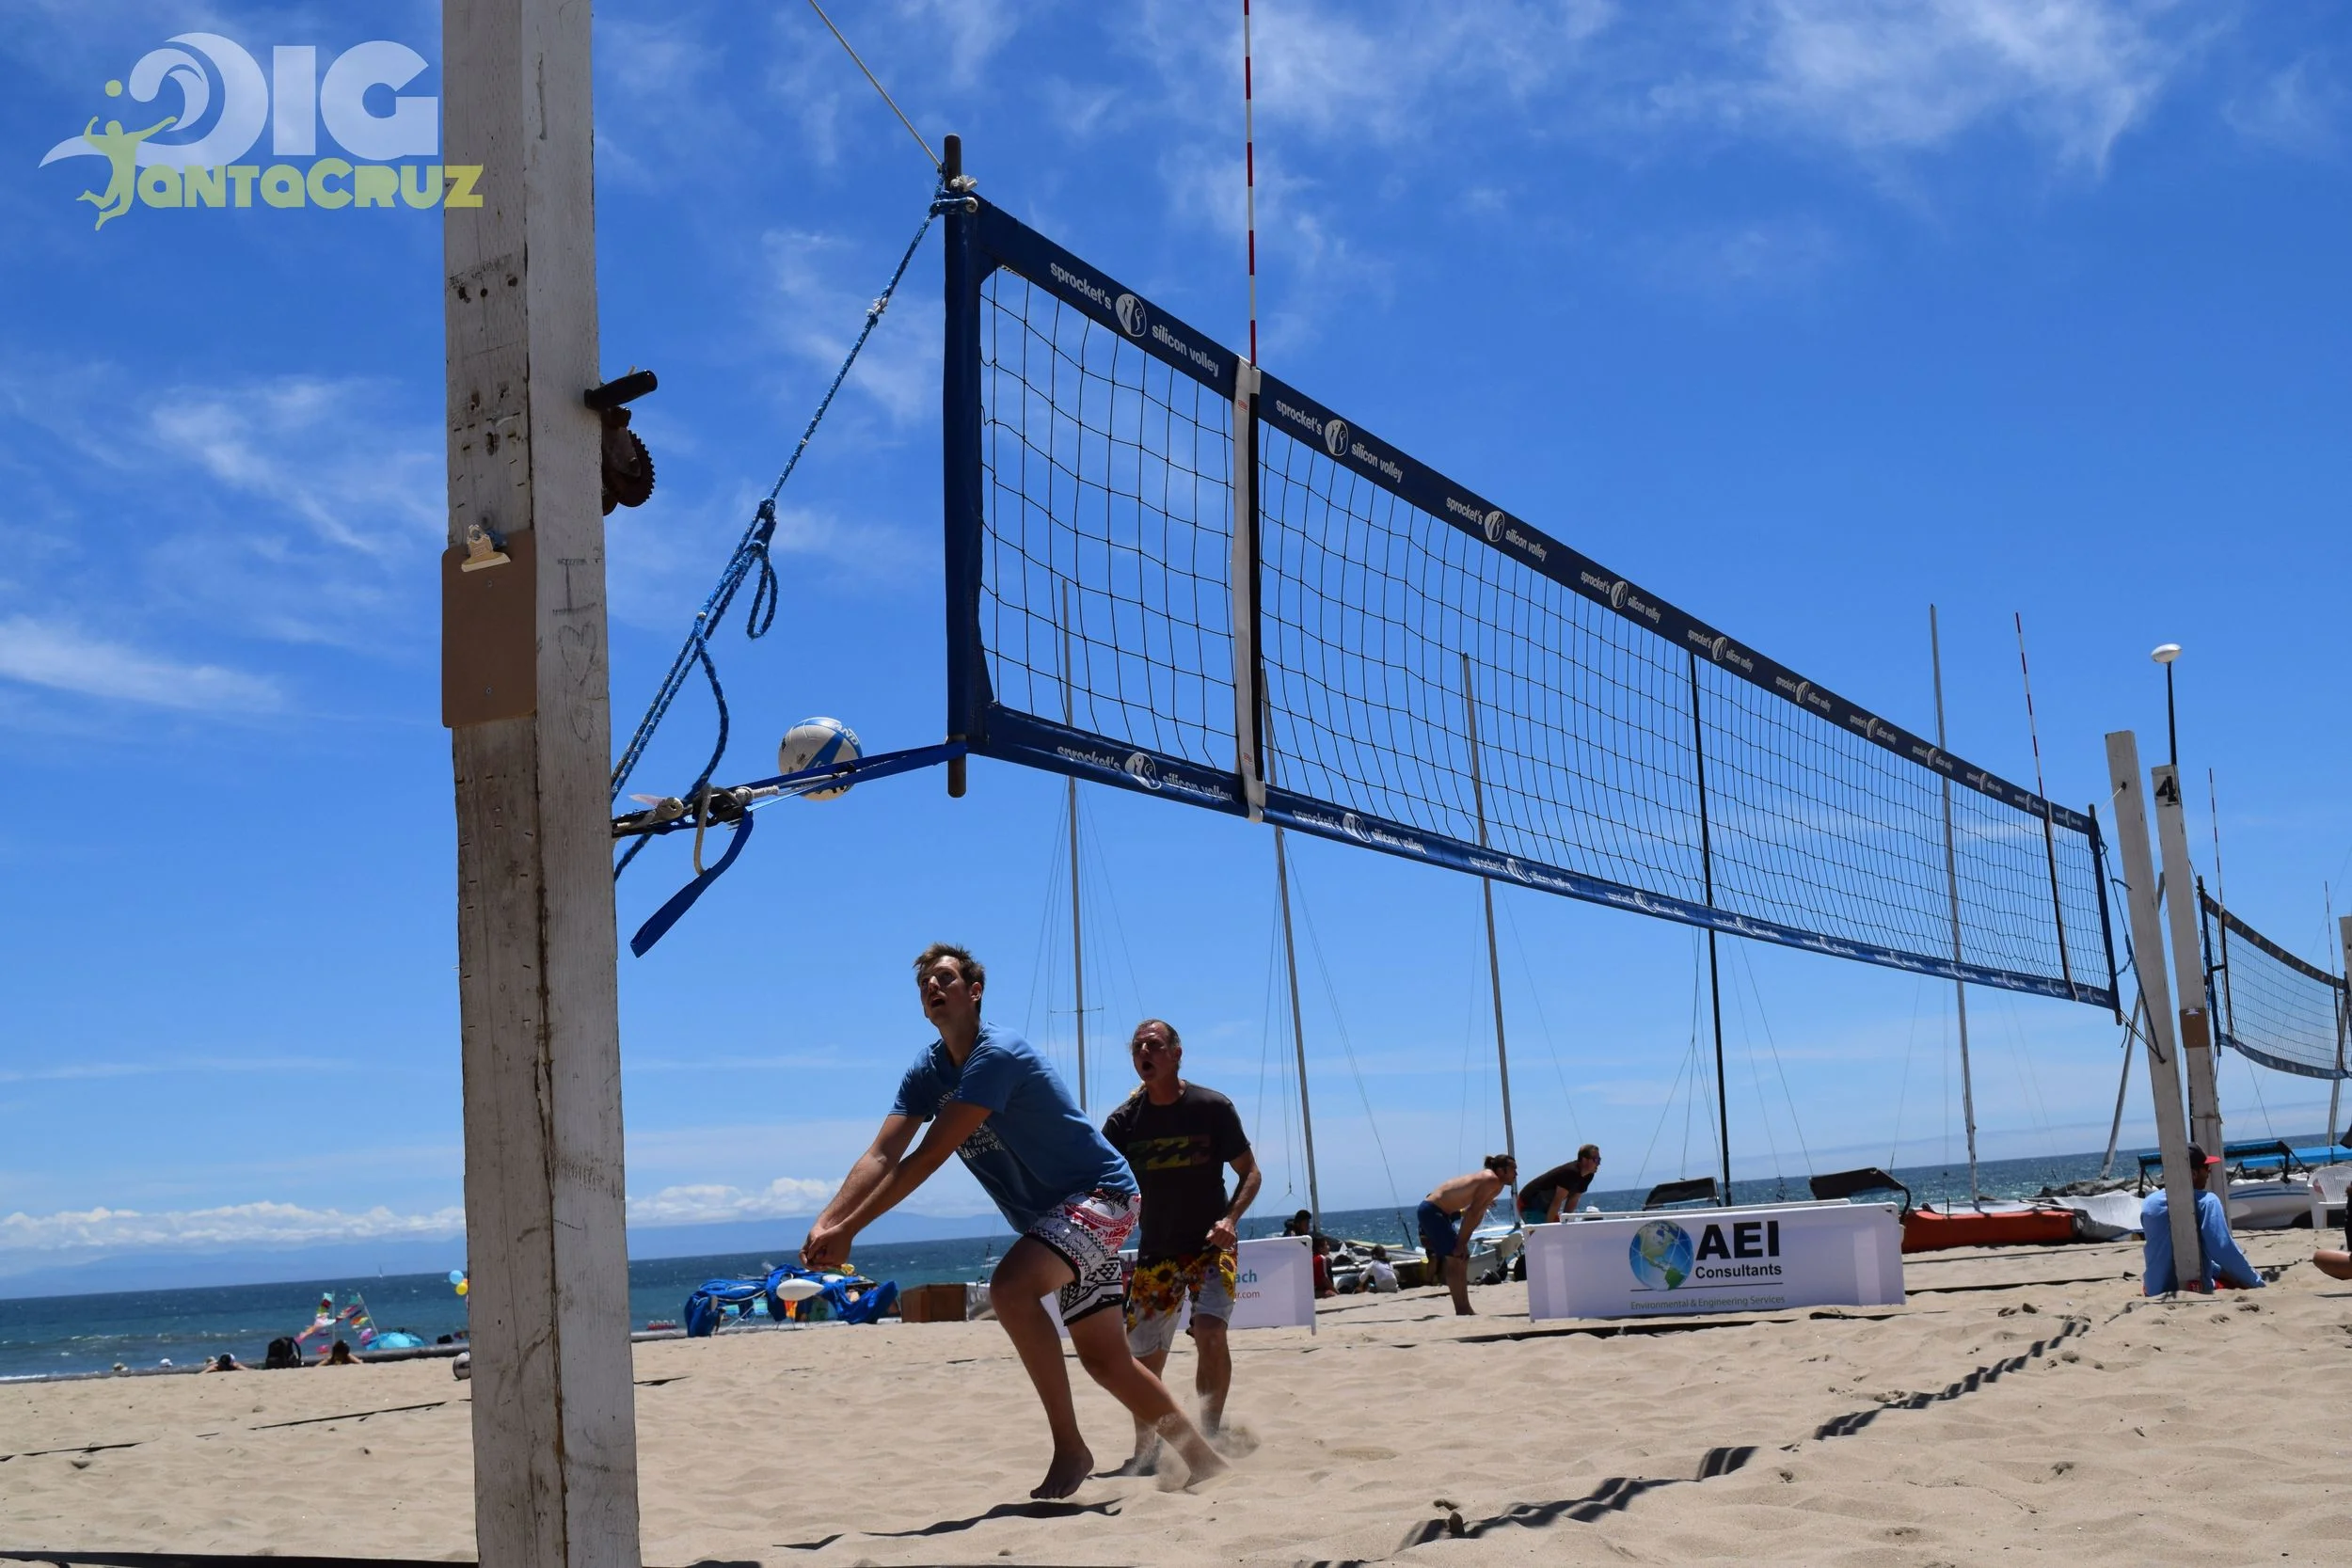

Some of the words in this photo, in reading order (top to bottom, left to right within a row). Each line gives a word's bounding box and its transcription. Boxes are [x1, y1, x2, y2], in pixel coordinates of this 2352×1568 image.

[1050, 262, 1112, 310] sprocket's
[1152, 324, 1187, 356] silicon
[1189, 345, 1219, 377] volley
[1276, 400, 1323, 436] sprocket's
[1351, 442, 1378, 467] silicon
[1379, 458, 1403, 483] volley
[1446, 497, 1484, 525] sprocket's
[1505, 529, 1528, 549] silicon
[1528, 542, 1547, 562] volley
[2155, 775, 2176, 802] 4
[1695, 1220, 1780, 1260] AEI
[1234, 1268, 1258, 1283] ach
[1695, 1263, 1782, 1279] Consultants
[1630, 1297, 1689, 1310] Environmental
[1690, 1297, 1697, 1307] &
[1698, 1296, 1748, 1308] Engineering
[1749, 1294, 1786, 1306] Services
